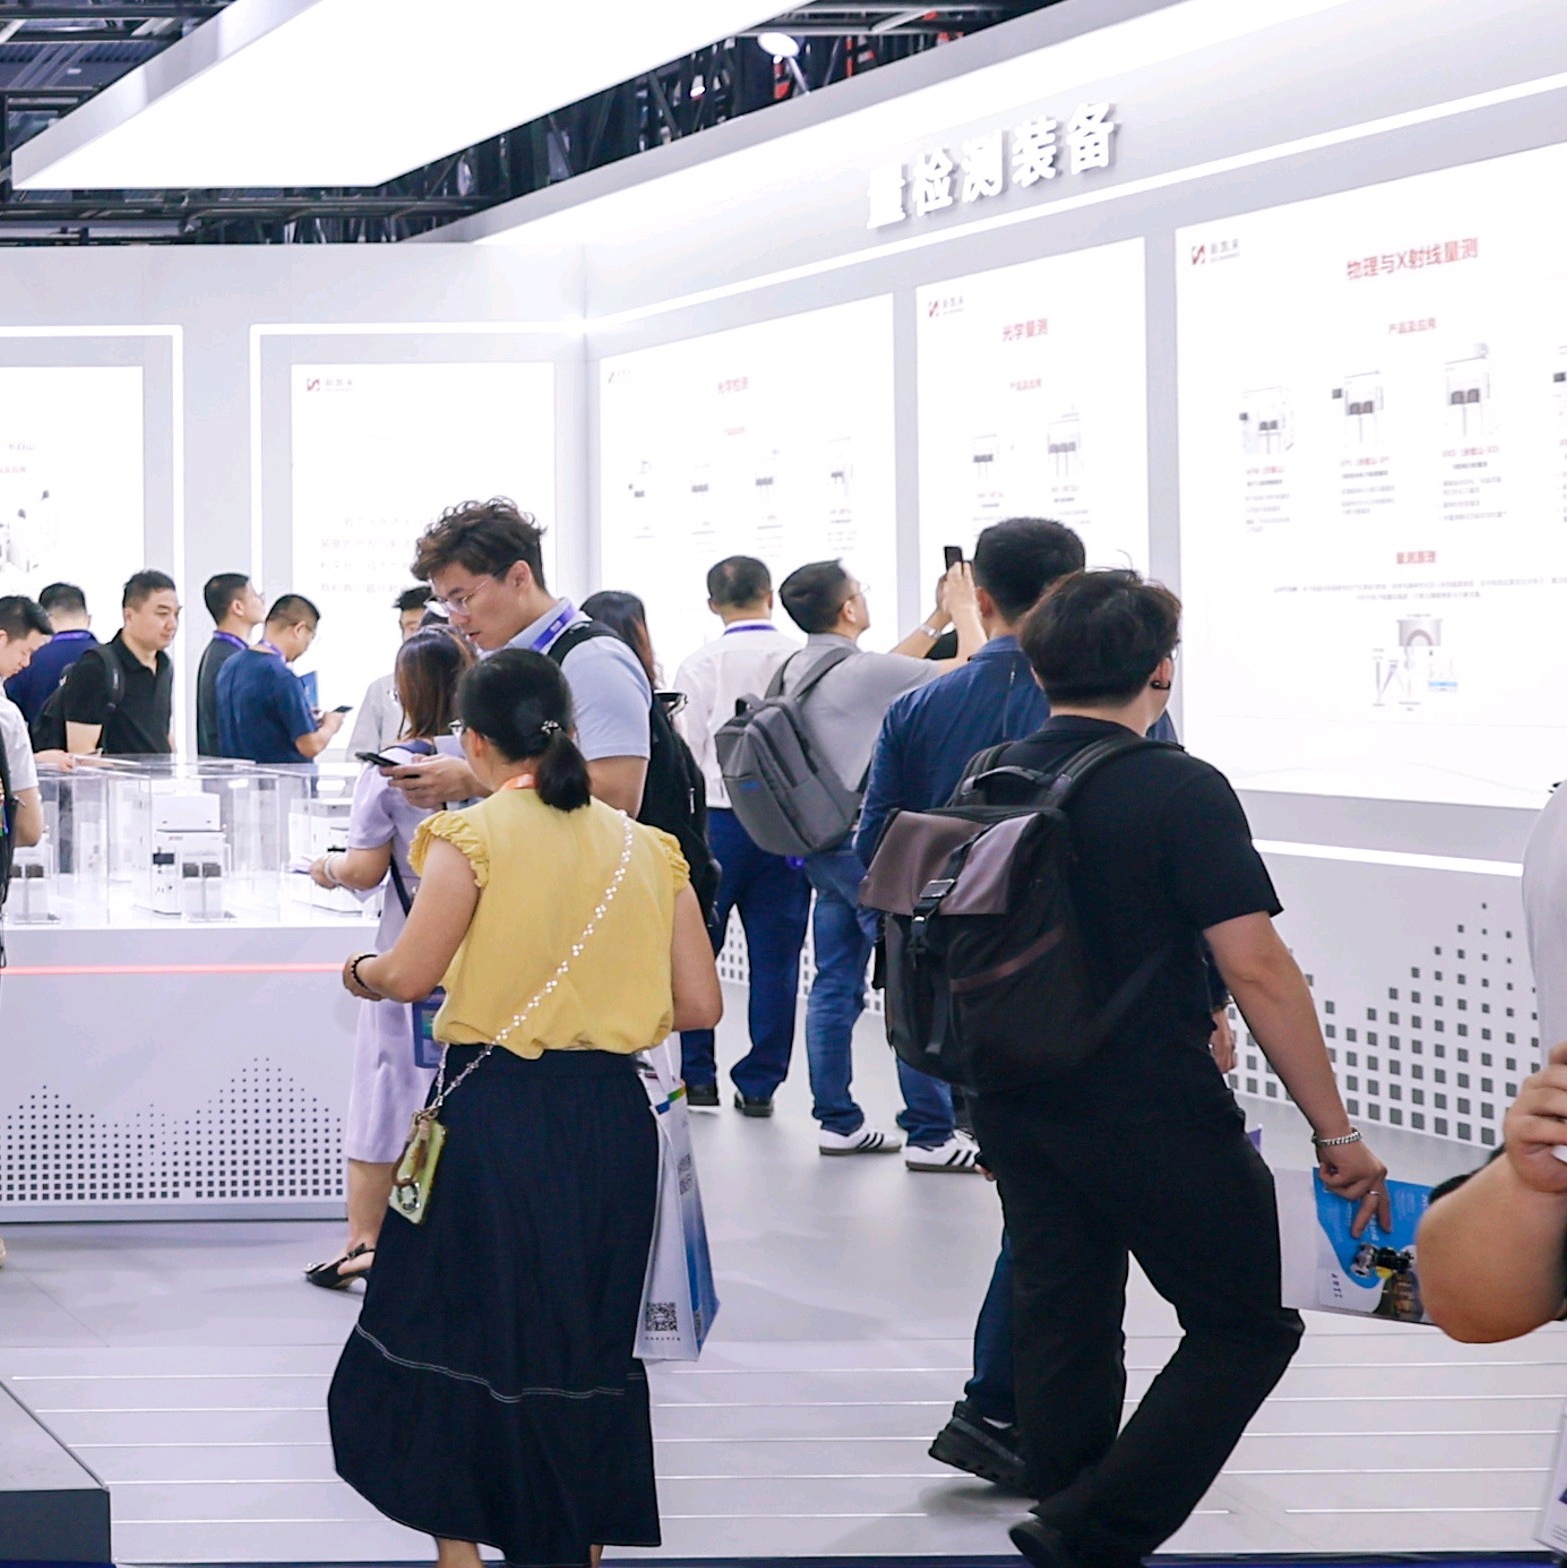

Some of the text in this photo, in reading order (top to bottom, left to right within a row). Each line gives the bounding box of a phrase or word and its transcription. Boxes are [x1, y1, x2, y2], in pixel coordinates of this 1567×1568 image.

[866, 101, 1117, 230] 量检测装备
[1345, 235, 1479, 280] 物理与X射线量测
